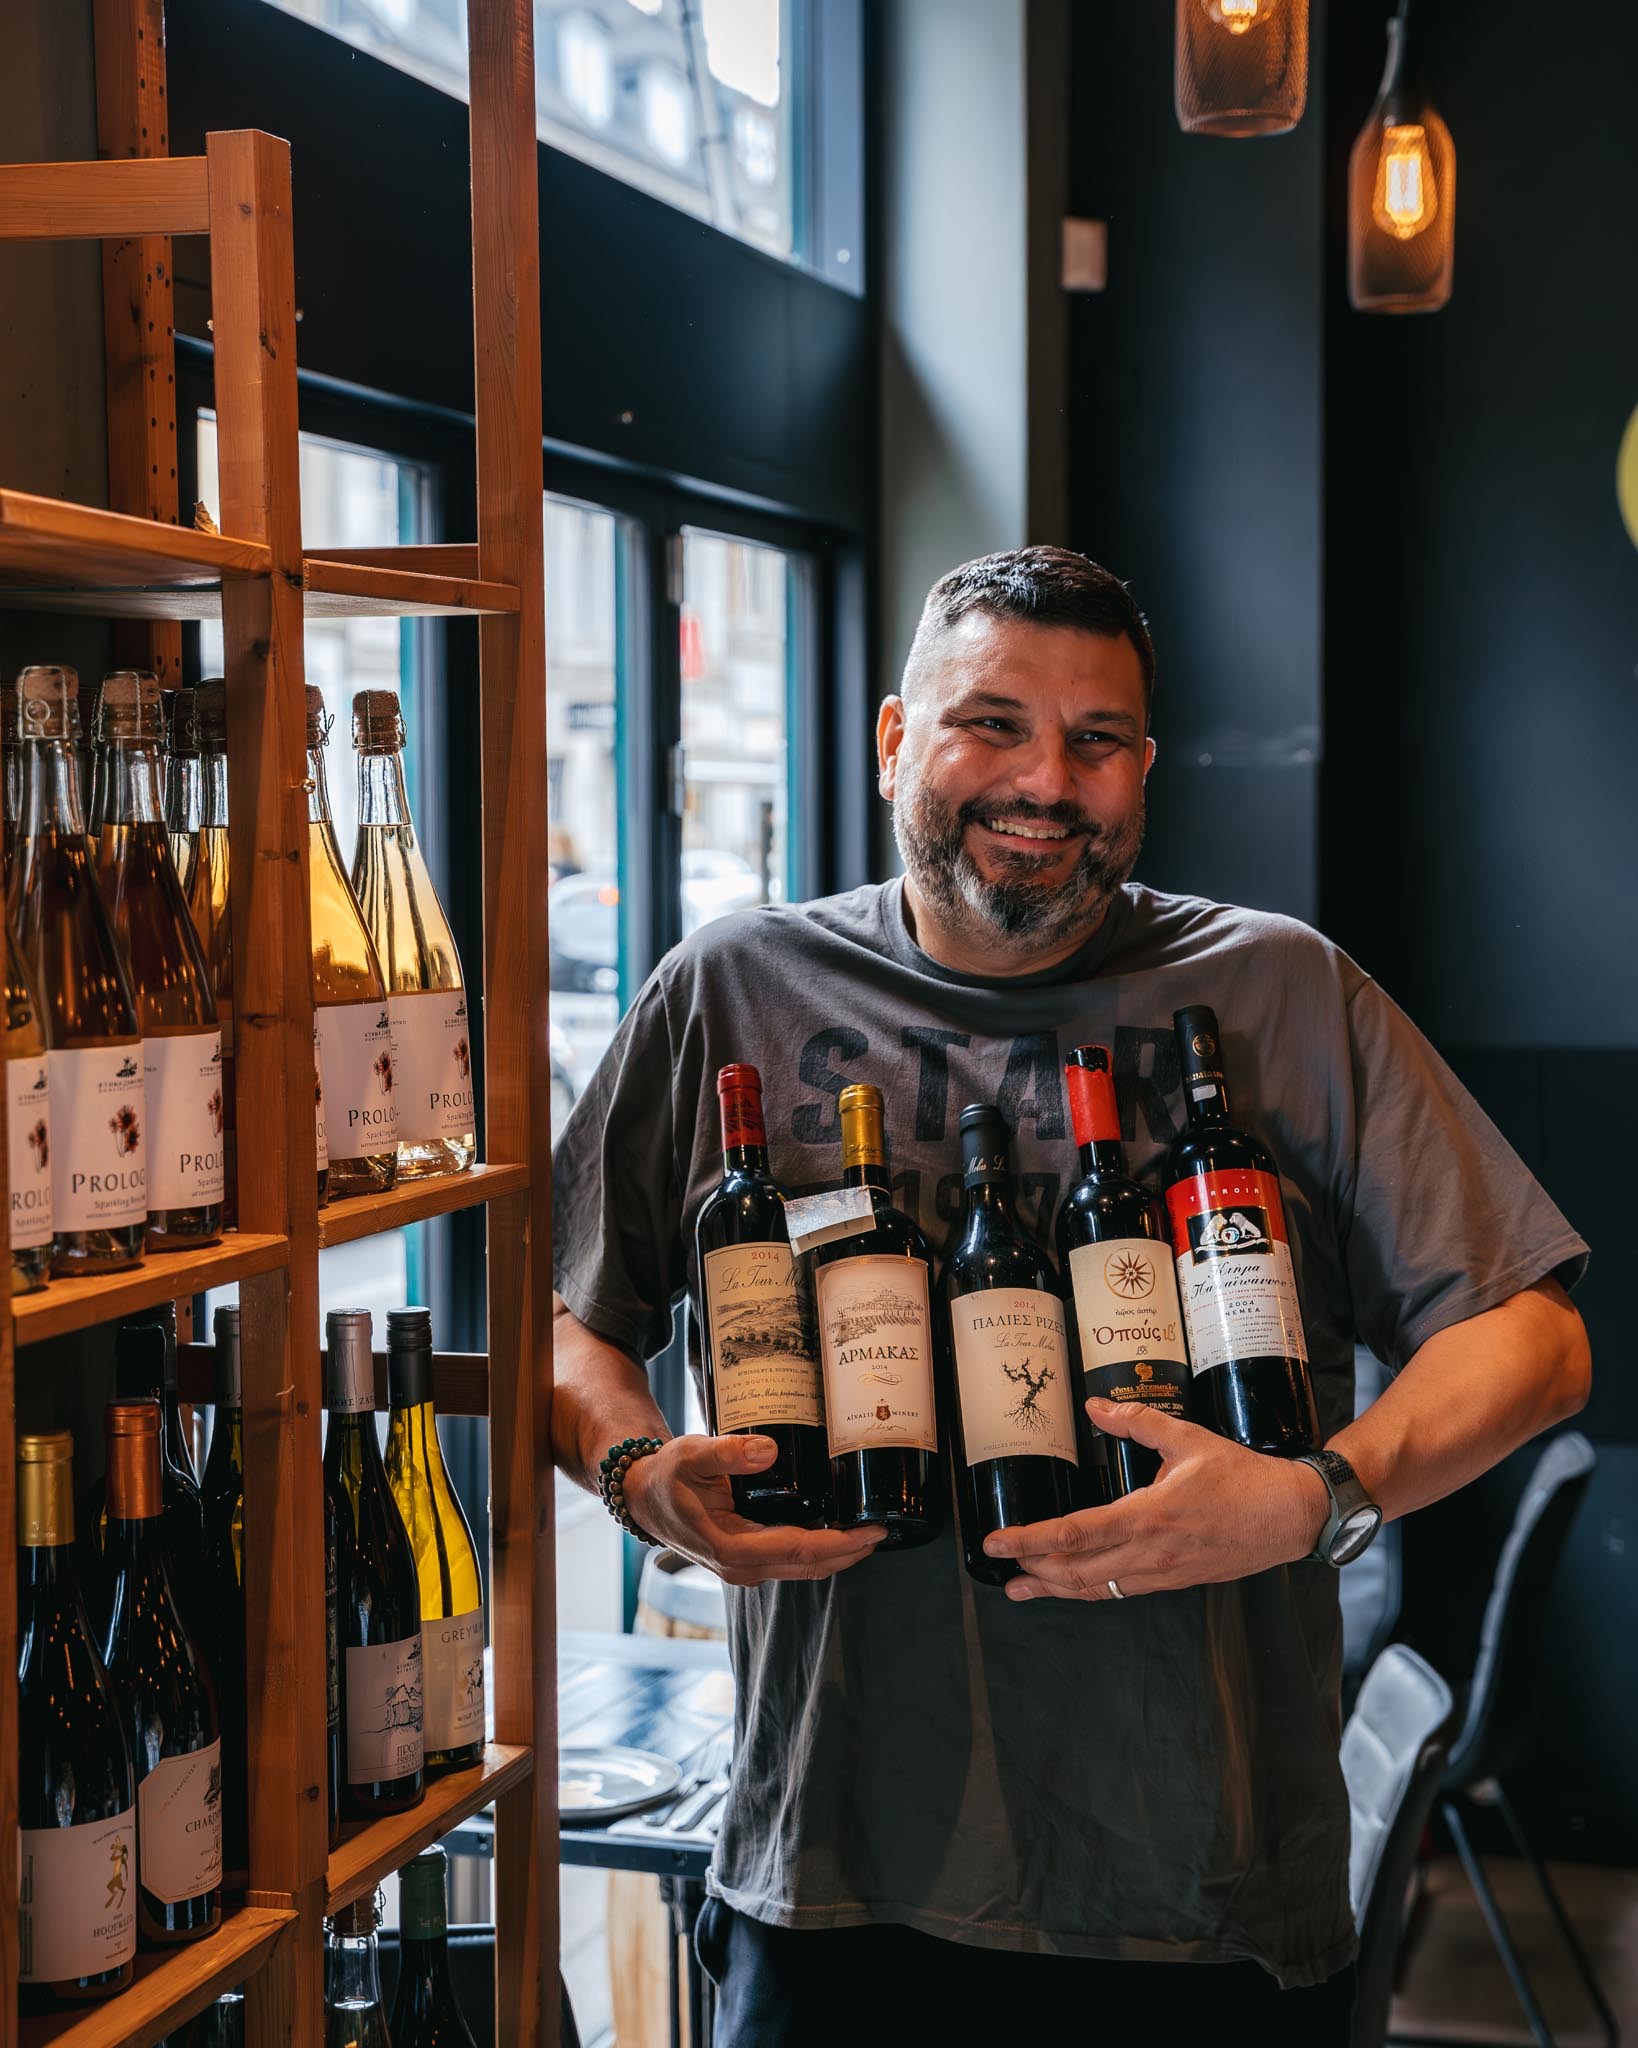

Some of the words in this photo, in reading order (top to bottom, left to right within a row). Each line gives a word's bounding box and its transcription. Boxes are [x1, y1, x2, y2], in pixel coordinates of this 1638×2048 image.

[791, 1026, 1184, 1145] STAR
[1190, 1187, 1261, 1203] TRROIR
[751, 1251, 780, 1263] 2014
[720, 1265, 741, 1293] La
[741, 1264, 776, 1289] Tour
[1190, 1276, 1287, 1300] Πααϊωάννου
[1014, 1301, 1037, 1312] 2014
[1228, 1300, 1255, 1309] 2004
[972, 1314, 1032, 1331] ΠΑΛΙΕΣ
[1011, 1332, 1031, 1347] Tour
[838, 1345, 919, 1366] ΑΡΜΑΚΑΣ
[1149, 1402, 1171, 1410] FRANC
